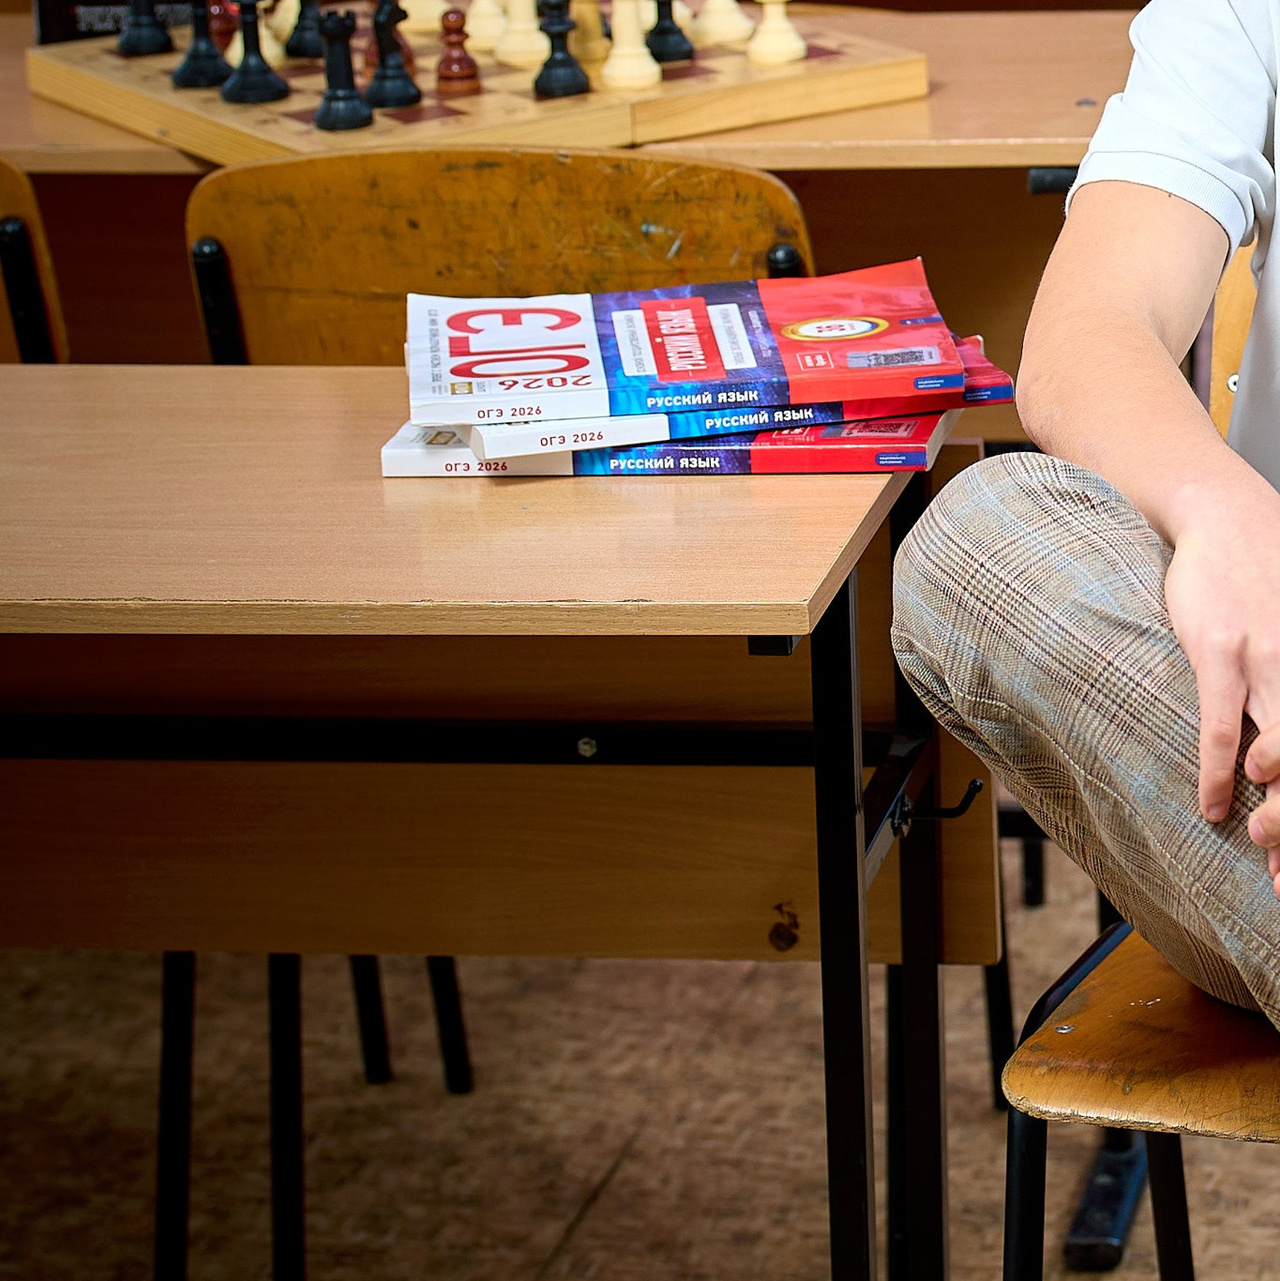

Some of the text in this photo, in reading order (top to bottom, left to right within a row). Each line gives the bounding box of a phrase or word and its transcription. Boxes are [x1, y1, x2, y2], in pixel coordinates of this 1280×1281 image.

[446, 307, 590, 378] ОГЭ
[498, 374, 592, 391] 2026
[477, 390, 759, 419] ОГЭ 2026 РУССКИЙ ЯЗЫК
[540, 408, 814, 447] ОГЭ 2026 РУССКИЙ ЯЗЫК
[445, 456, 720, 472] ОГЭ 2026 РУССКИЙ ЯЗЫК
